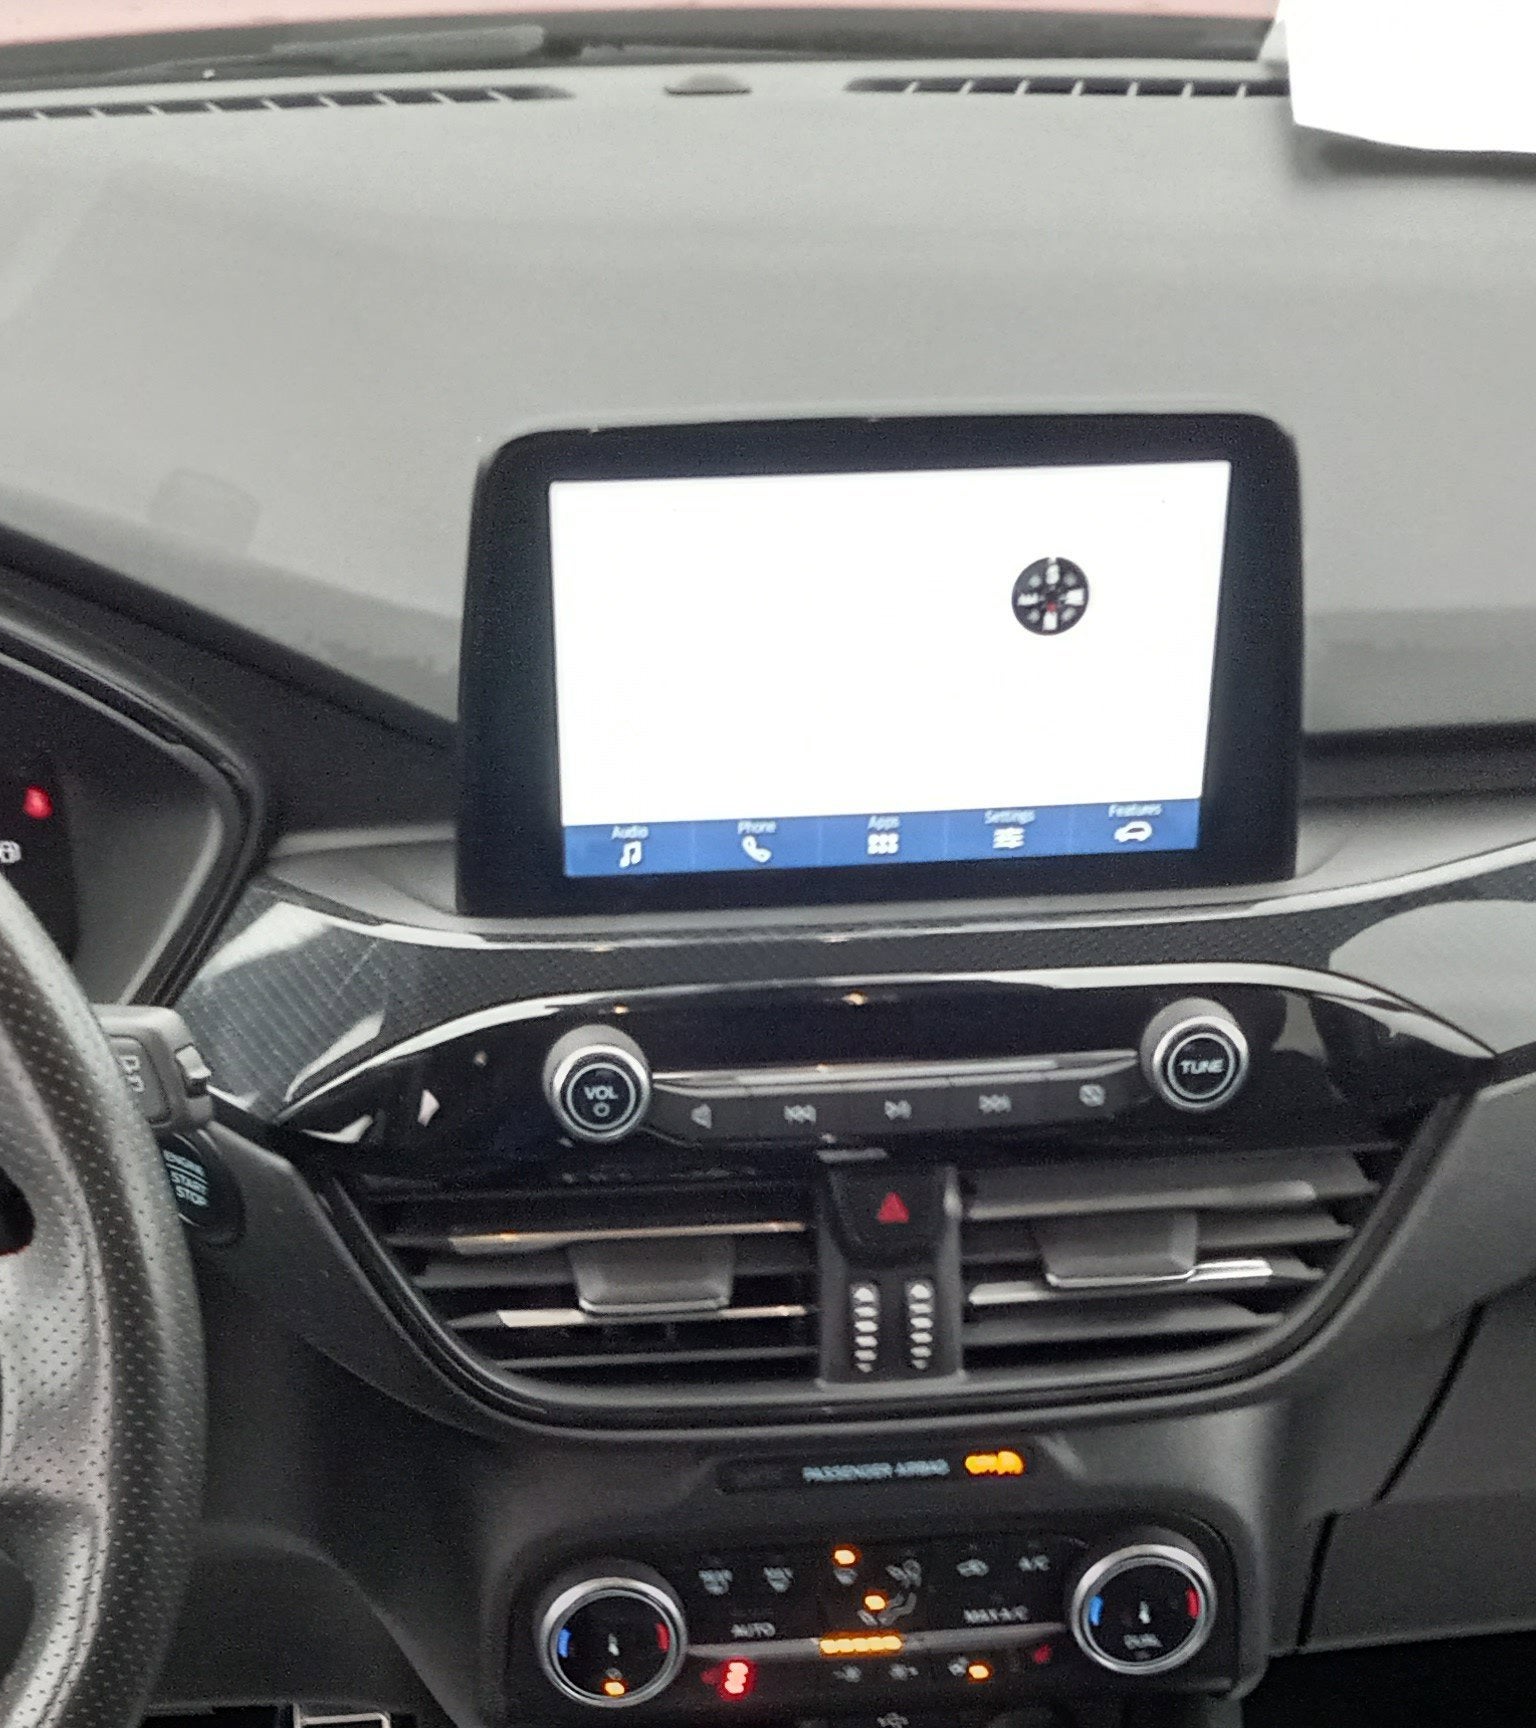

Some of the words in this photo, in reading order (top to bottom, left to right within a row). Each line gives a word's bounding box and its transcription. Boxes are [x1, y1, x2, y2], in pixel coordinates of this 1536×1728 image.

[1180, 1060, 1225, 1075] TUNE
[584, 1085, 619, 1100] VOL
[170, 1170, 208, 1195] START
[175, 1185, 208, 1206] STOP
[802, 1462, 893, 1482] PASSENGER
